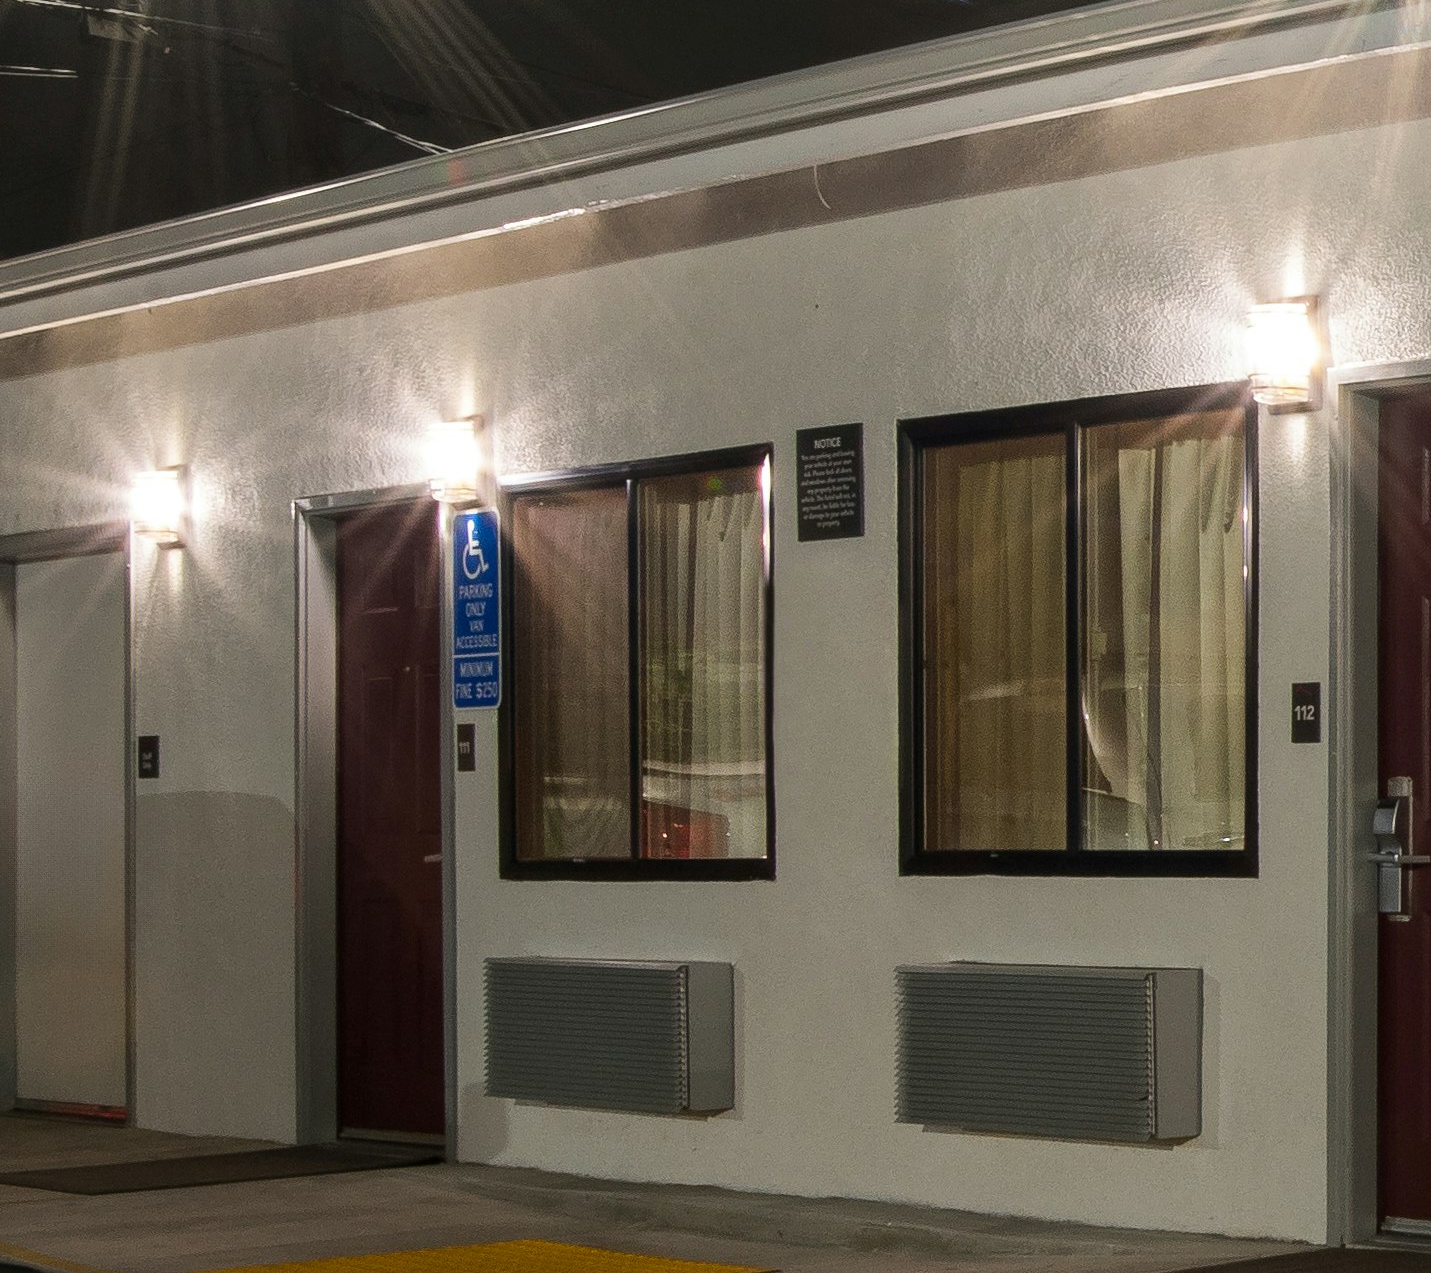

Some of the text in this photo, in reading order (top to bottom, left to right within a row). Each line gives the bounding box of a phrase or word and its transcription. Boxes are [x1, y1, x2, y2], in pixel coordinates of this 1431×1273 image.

[814, 436, 841, 449] NOTICE
[458, 583, 493, 599] PARKING
[465, 601, 487, 617] ONLY
[469, 619, 485, 632] VAN
[456, 633, 498, 649] ACCESSIBLE
[460, 661, 494, 677] MINIMUM
[456, 681, 498, 700] FINE $250
[1294, 704, 1315, 721] 112
